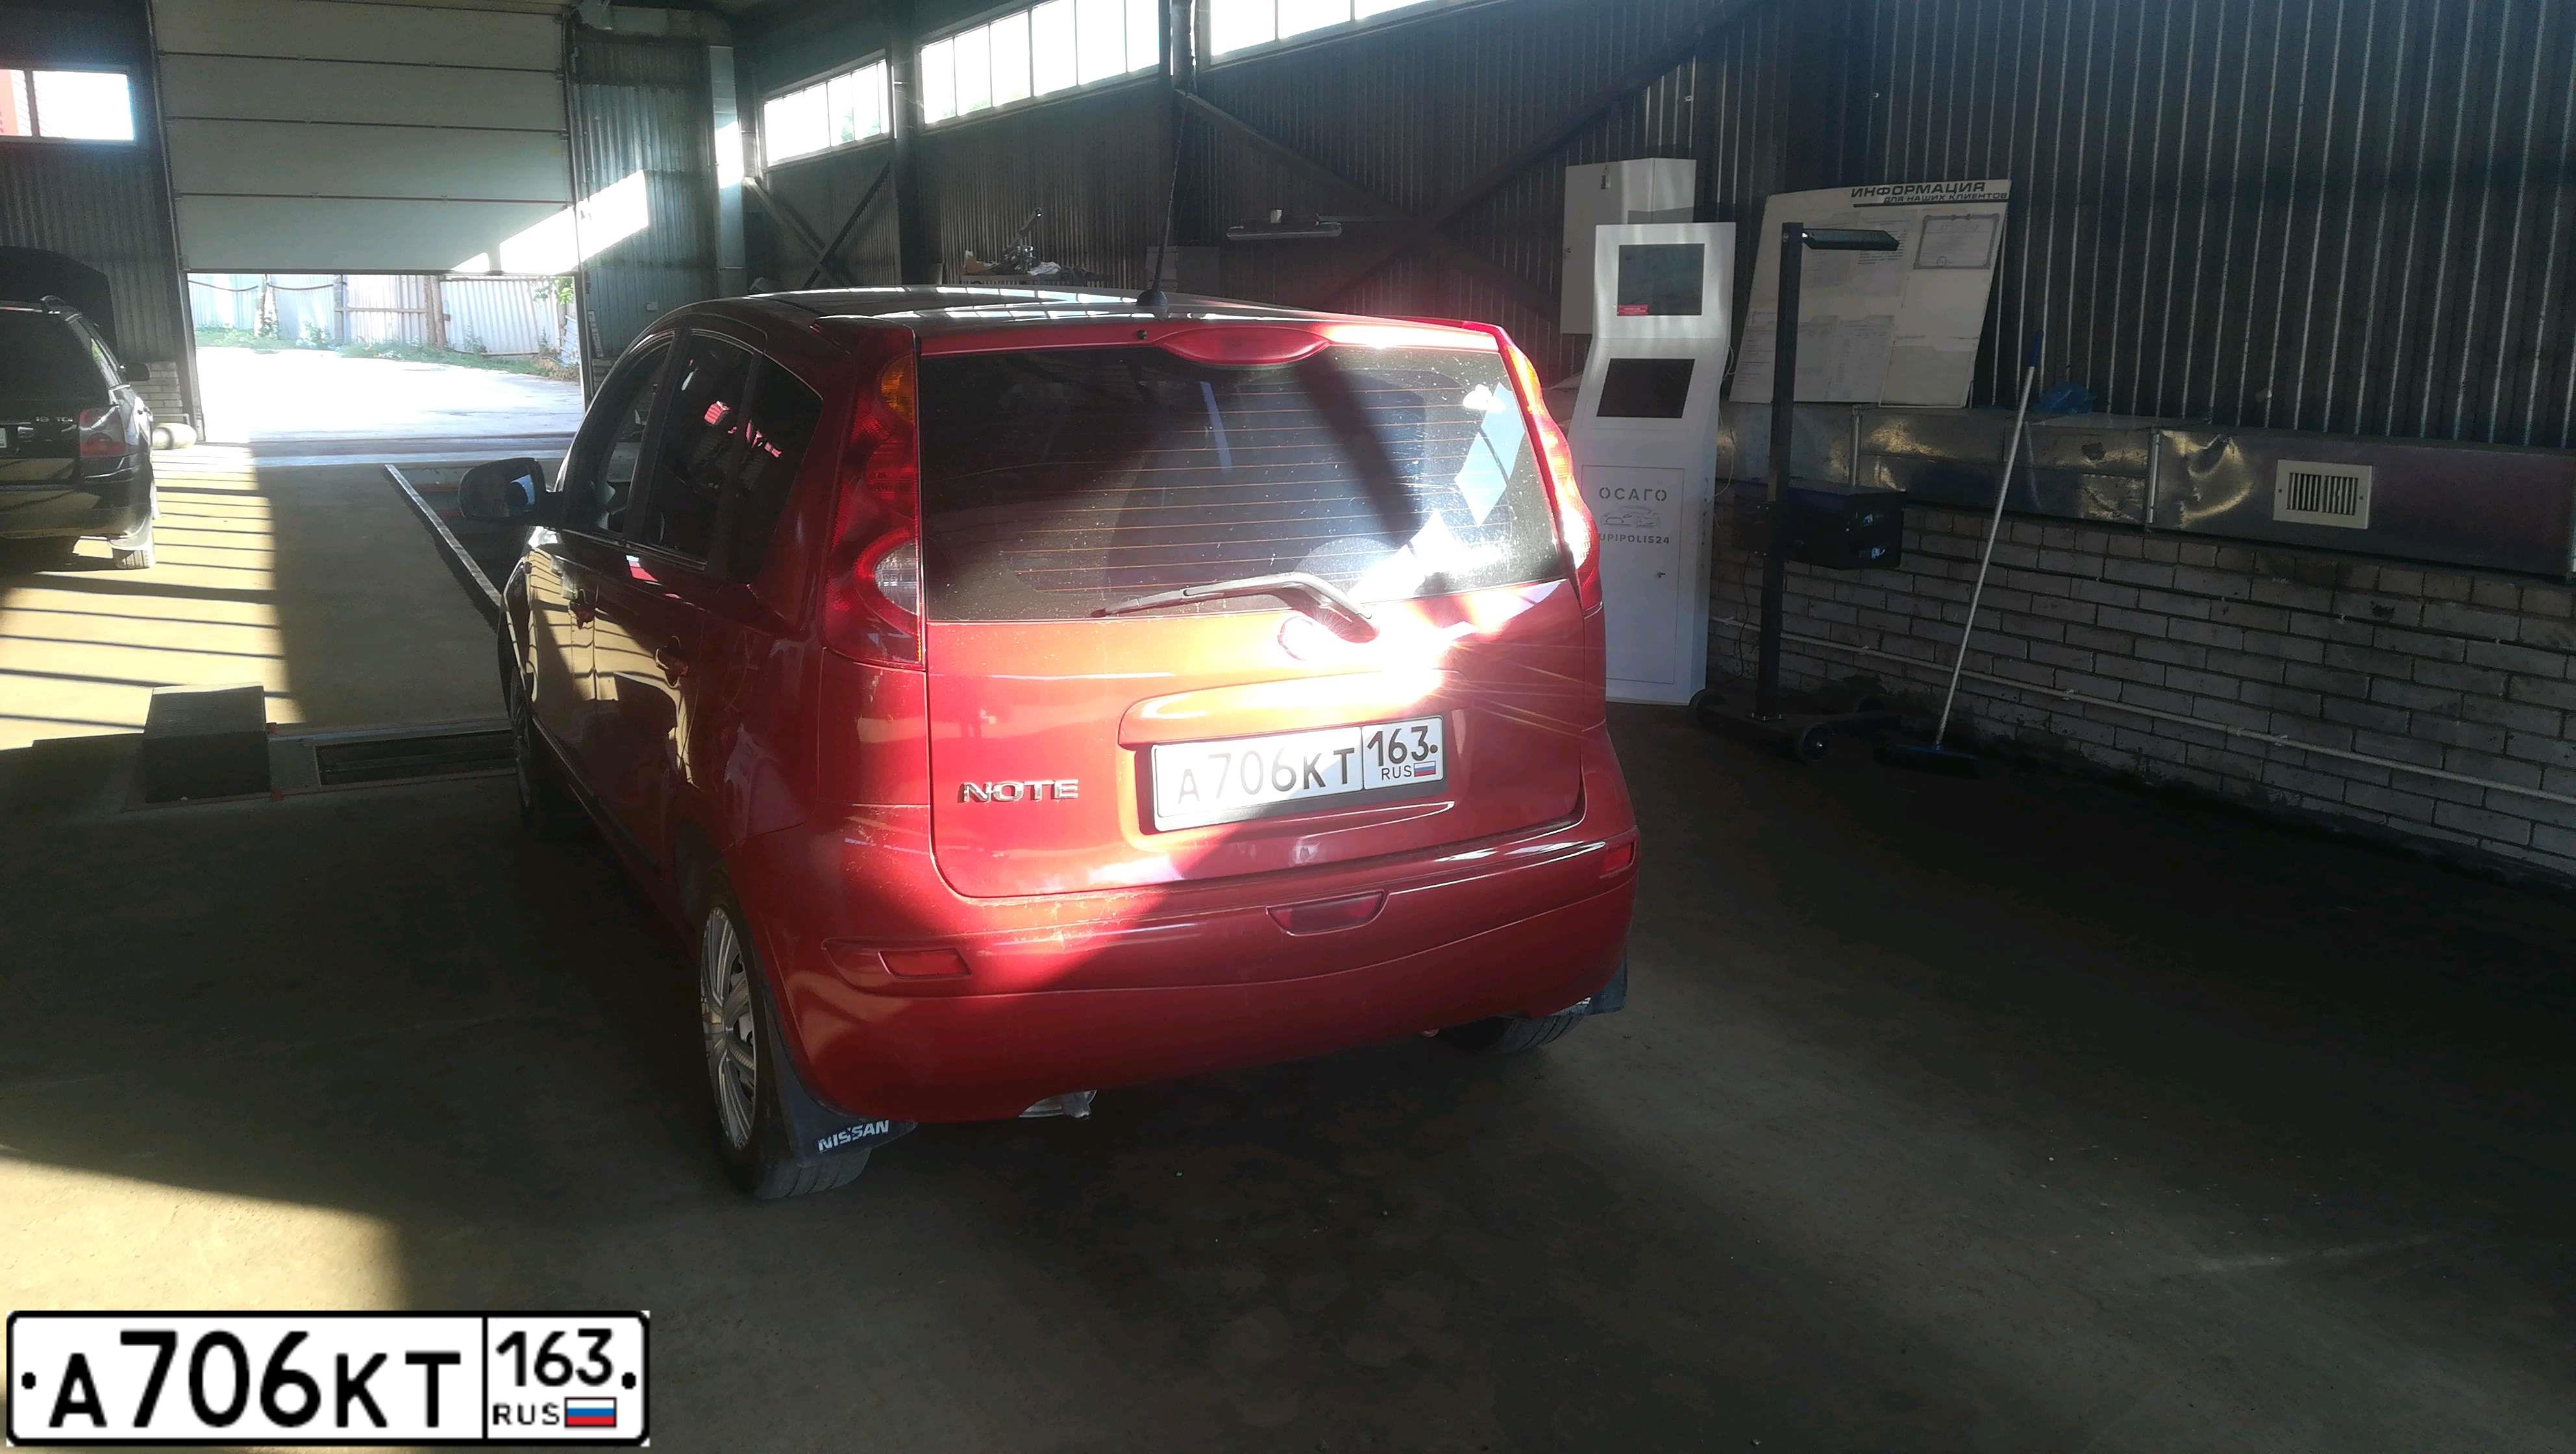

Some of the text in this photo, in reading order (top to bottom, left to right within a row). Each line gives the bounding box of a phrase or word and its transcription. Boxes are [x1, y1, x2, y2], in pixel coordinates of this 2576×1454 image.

[1851, 182, 1986, 197] ИНФОРМАЦИЯ
[1949, 192, 2007, 201] КЛИЕНТОВ
[1599, 487, 1667, 502] ОСАГО
[1599, 534, 1670, 544] UPIPOLIS24
[1178, 725, 1429, 804] А706КТ 163
[1381, 765, 1412, 780] RUS
[961, 779, 1080, 802] NOTE
[818, 1119, 890, 1152] NISSAN
